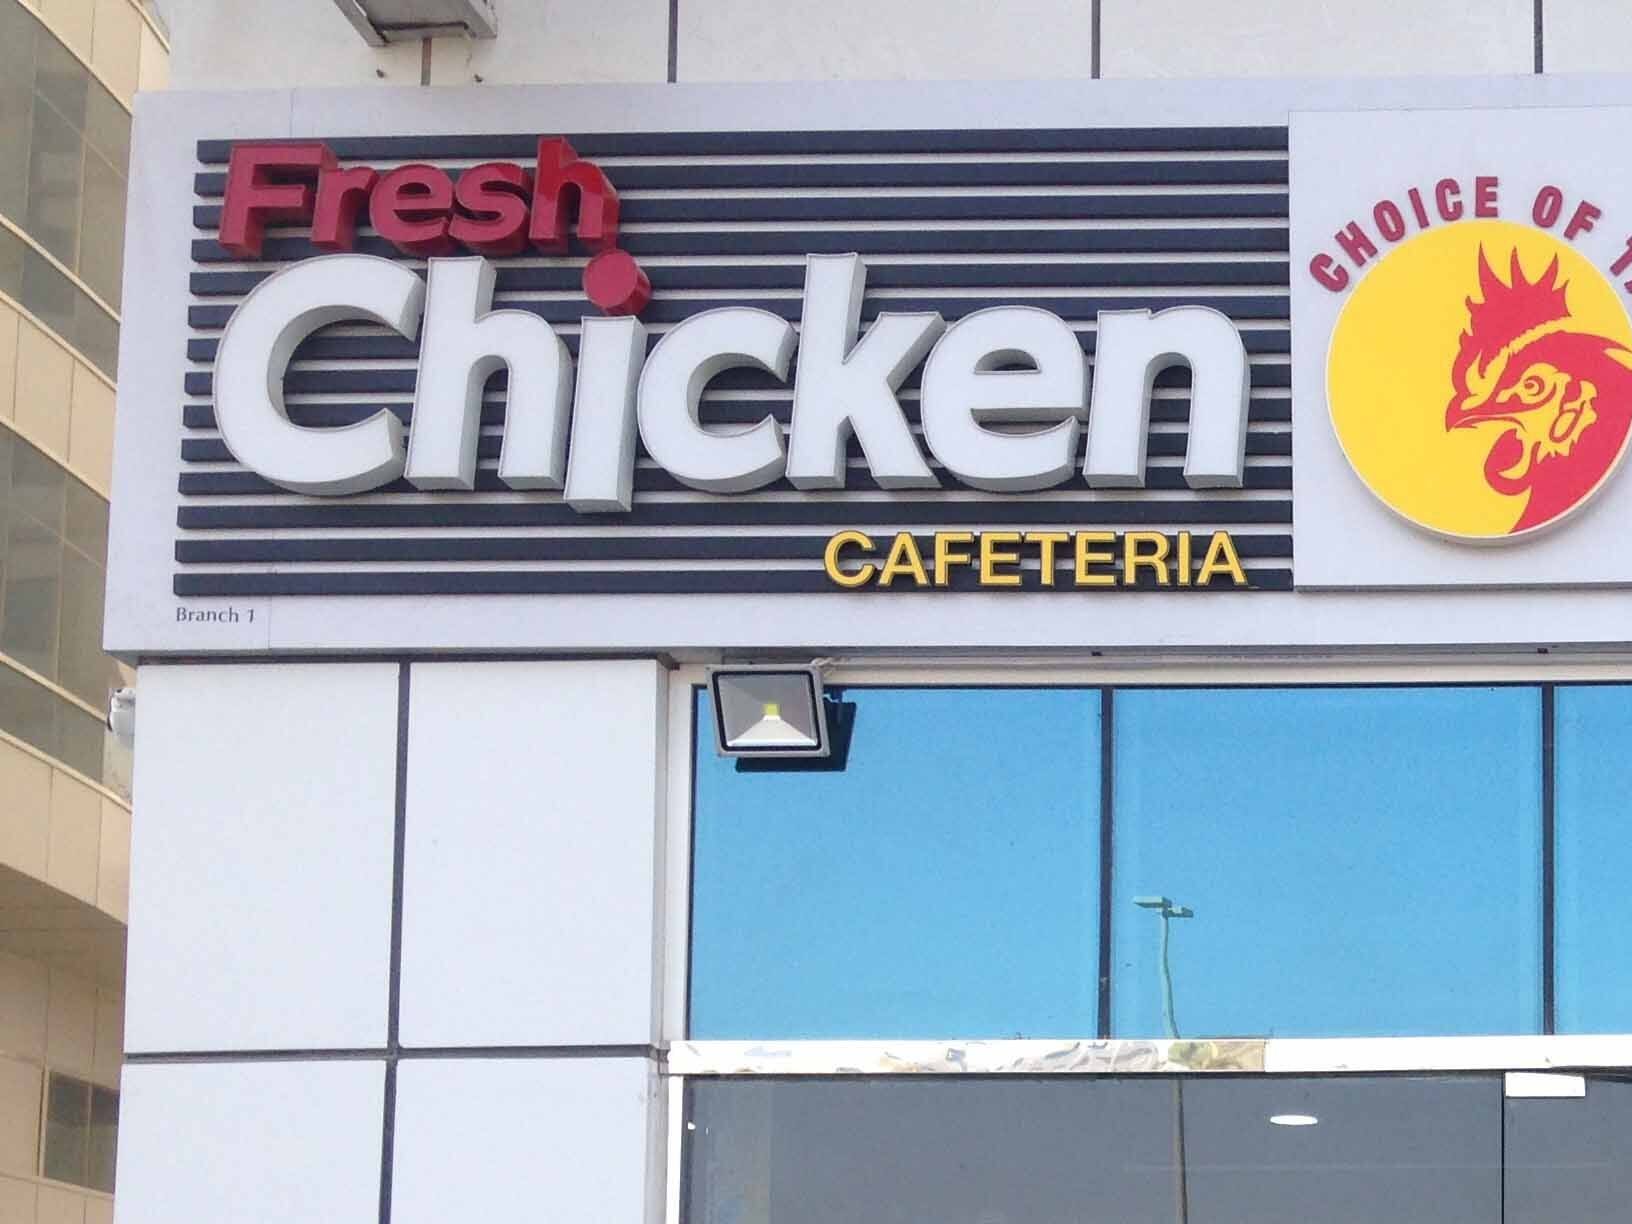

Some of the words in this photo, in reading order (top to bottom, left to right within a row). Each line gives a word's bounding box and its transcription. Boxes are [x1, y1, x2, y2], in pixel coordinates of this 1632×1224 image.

[217, 136, 621, 259] Fresh
[1309, 176, 1499, 293] CHOICE
[1531, 184, 1602, 241] OF
[212, 248, 1251, 513] Chicken
[176, 606, 239, 623] Branch
[247, 608, 255, 623] 1
[822, 529, 1248, 588] CAFETERIA
